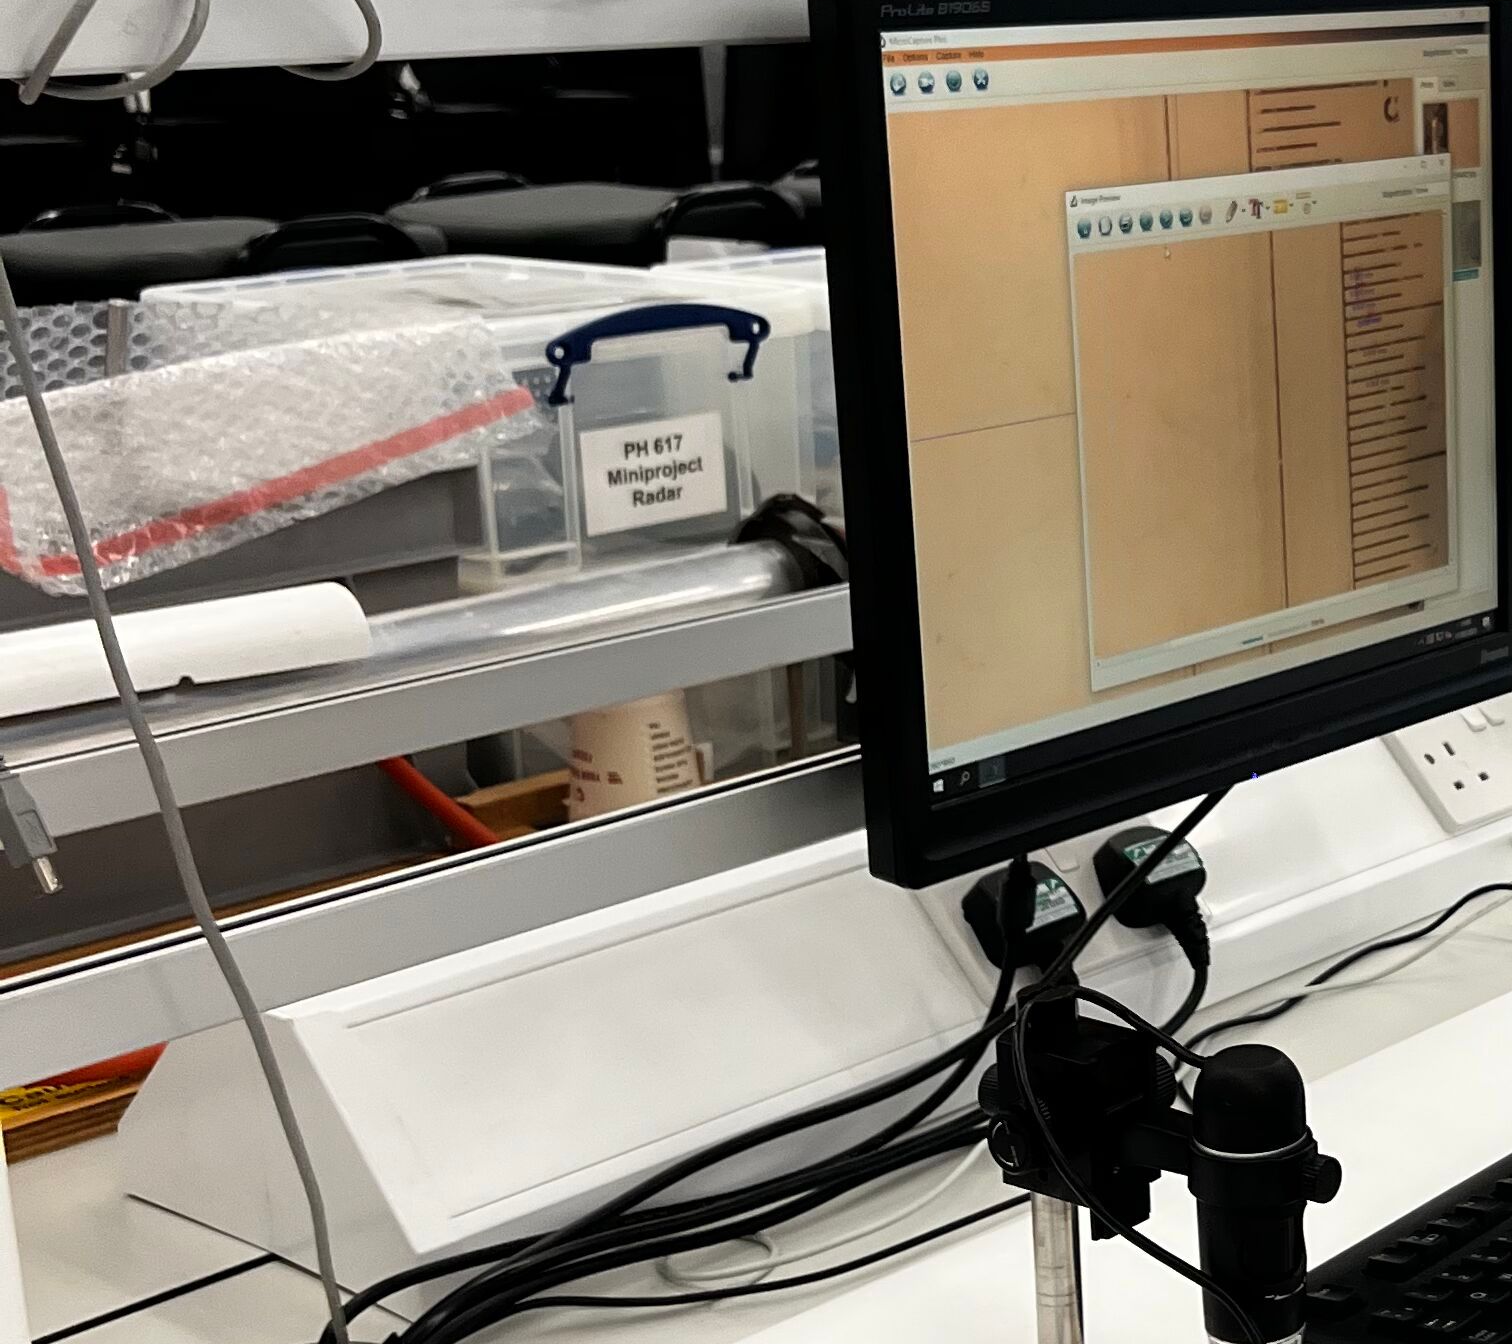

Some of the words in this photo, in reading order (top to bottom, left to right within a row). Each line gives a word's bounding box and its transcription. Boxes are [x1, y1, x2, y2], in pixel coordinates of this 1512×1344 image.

[624, 440, 649, 460] PH
[654, 434, 683, 455] 617
[607, 456, 703, 489] Miniproject
[632, 486, 683, 508] Radar
